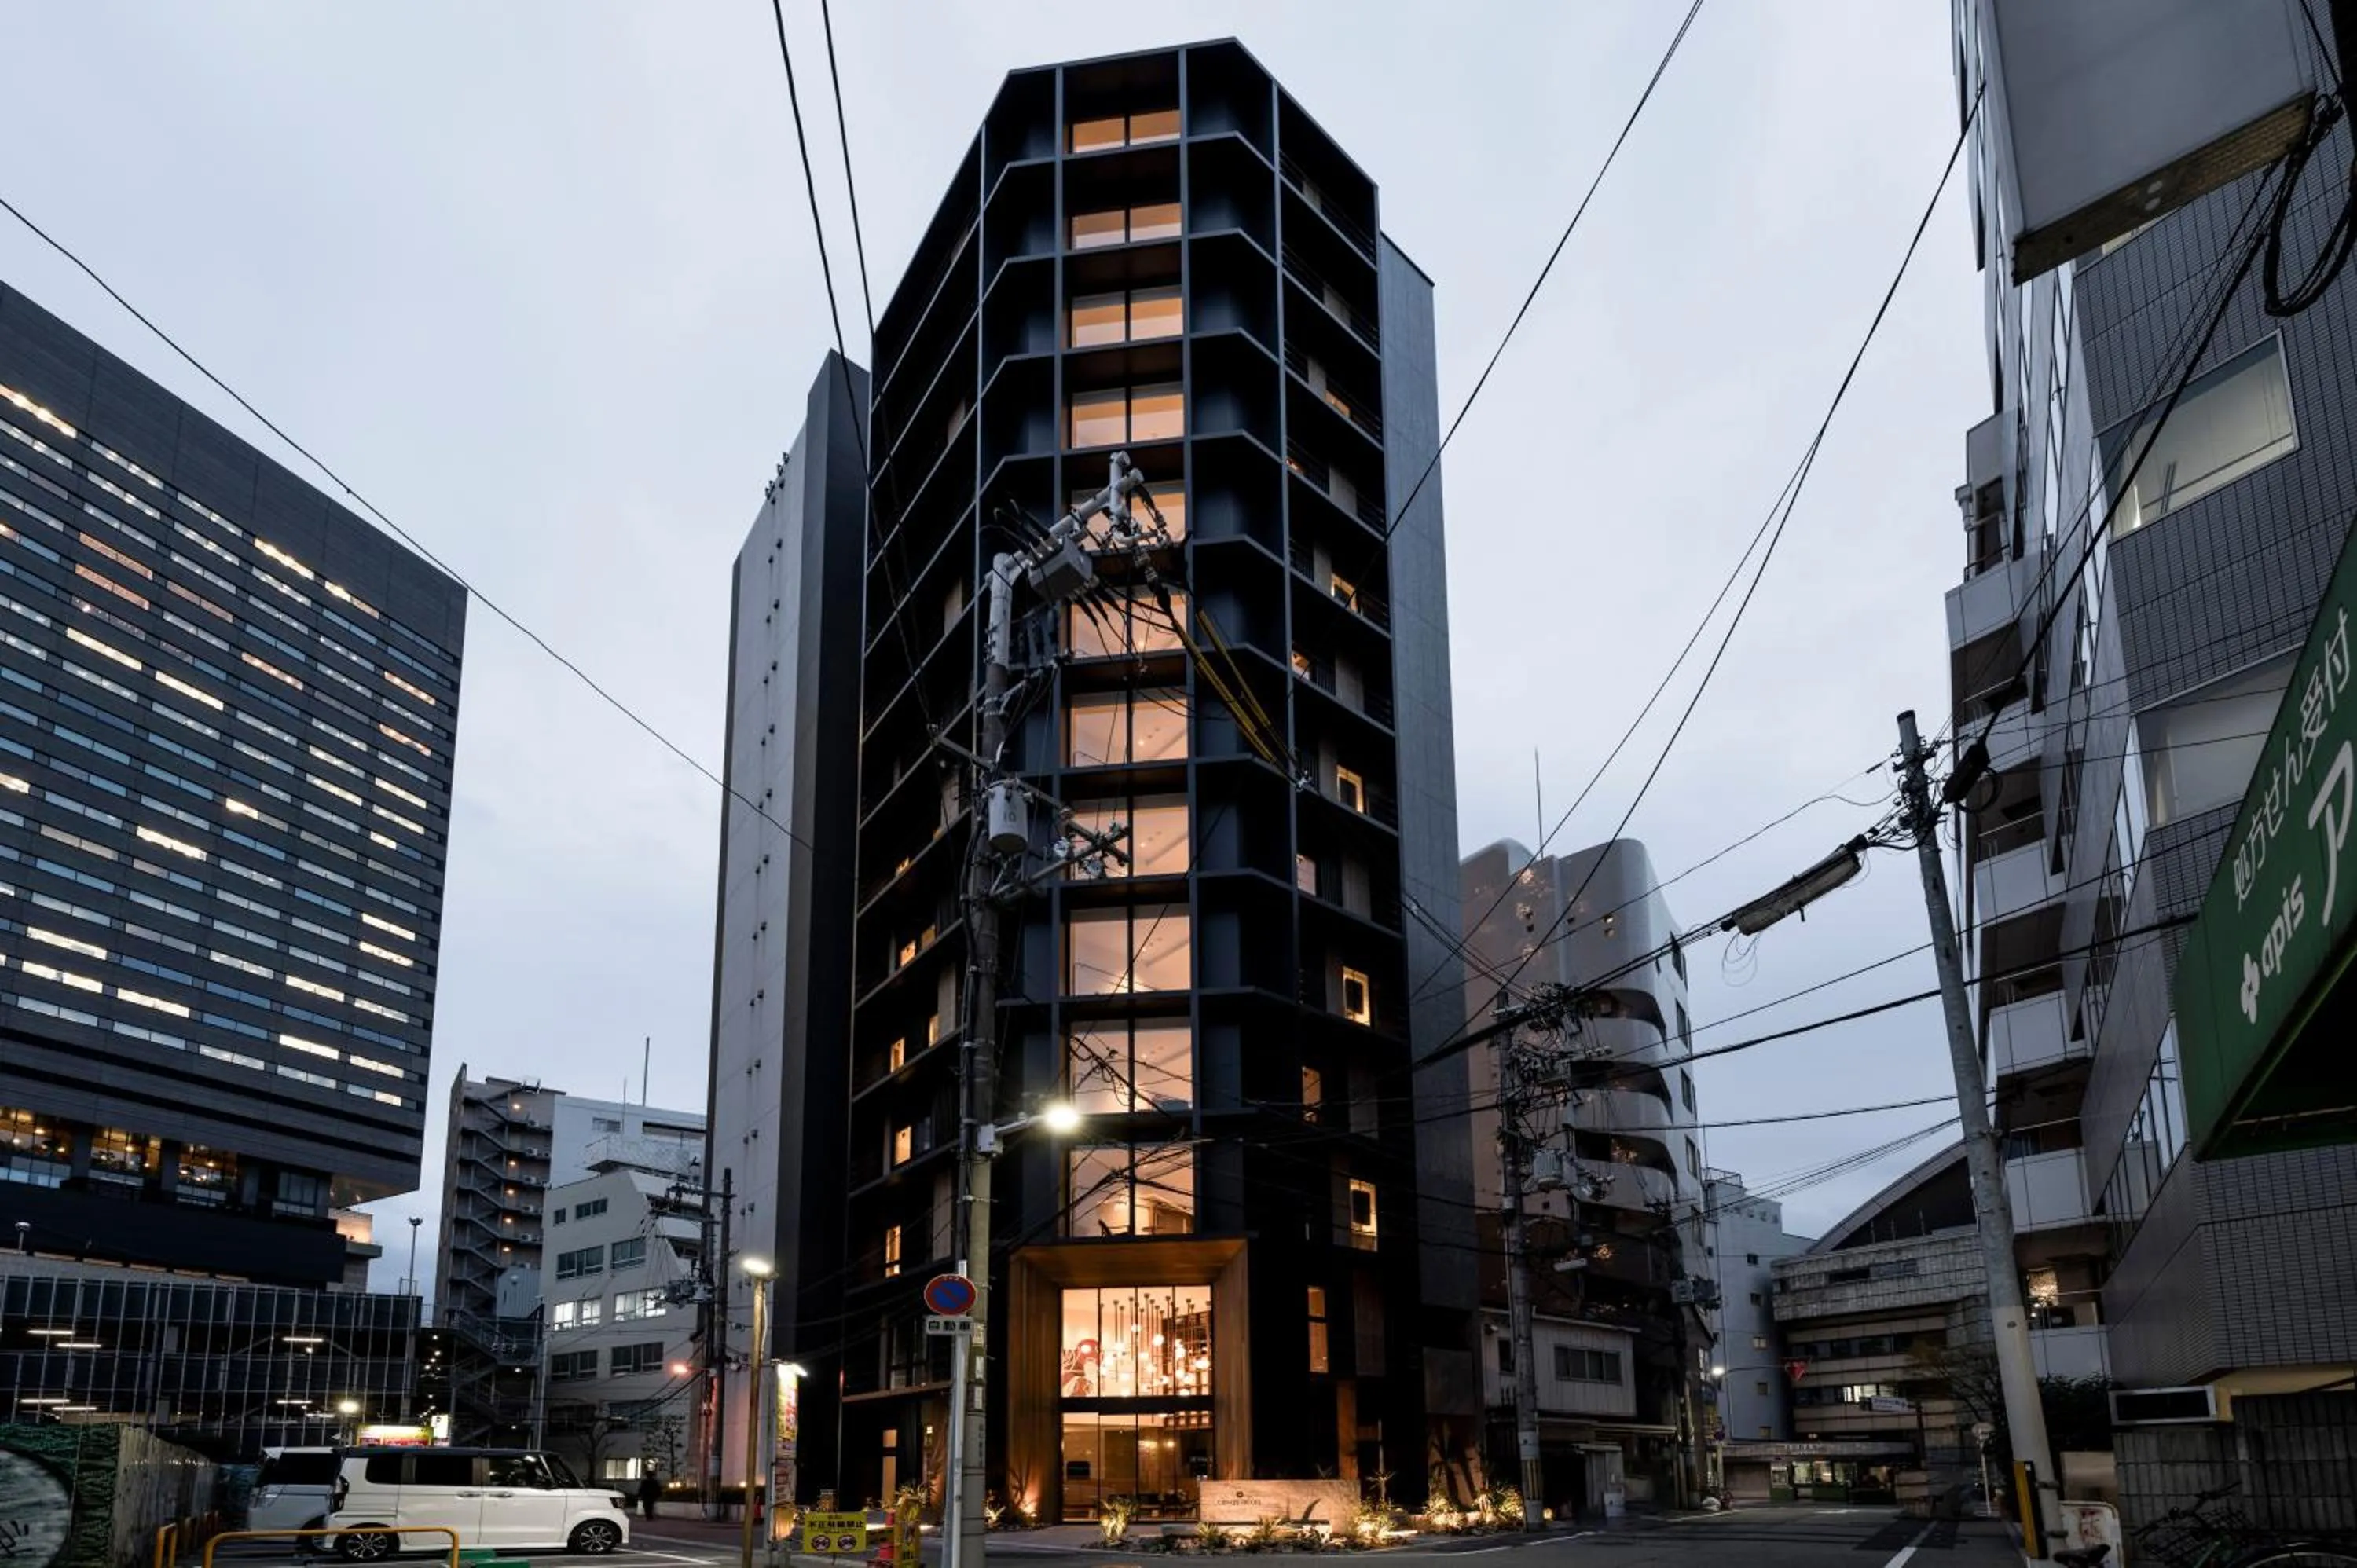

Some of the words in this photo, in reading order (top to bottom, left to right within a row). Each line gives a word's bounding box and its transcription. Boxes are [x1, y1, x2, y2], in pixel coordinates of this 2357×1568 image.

[2234, 607, 2350, 912] 処方せん受付
[2308, 739, 2354, 927] ア
[2262, 873, 2304, 978] apis
